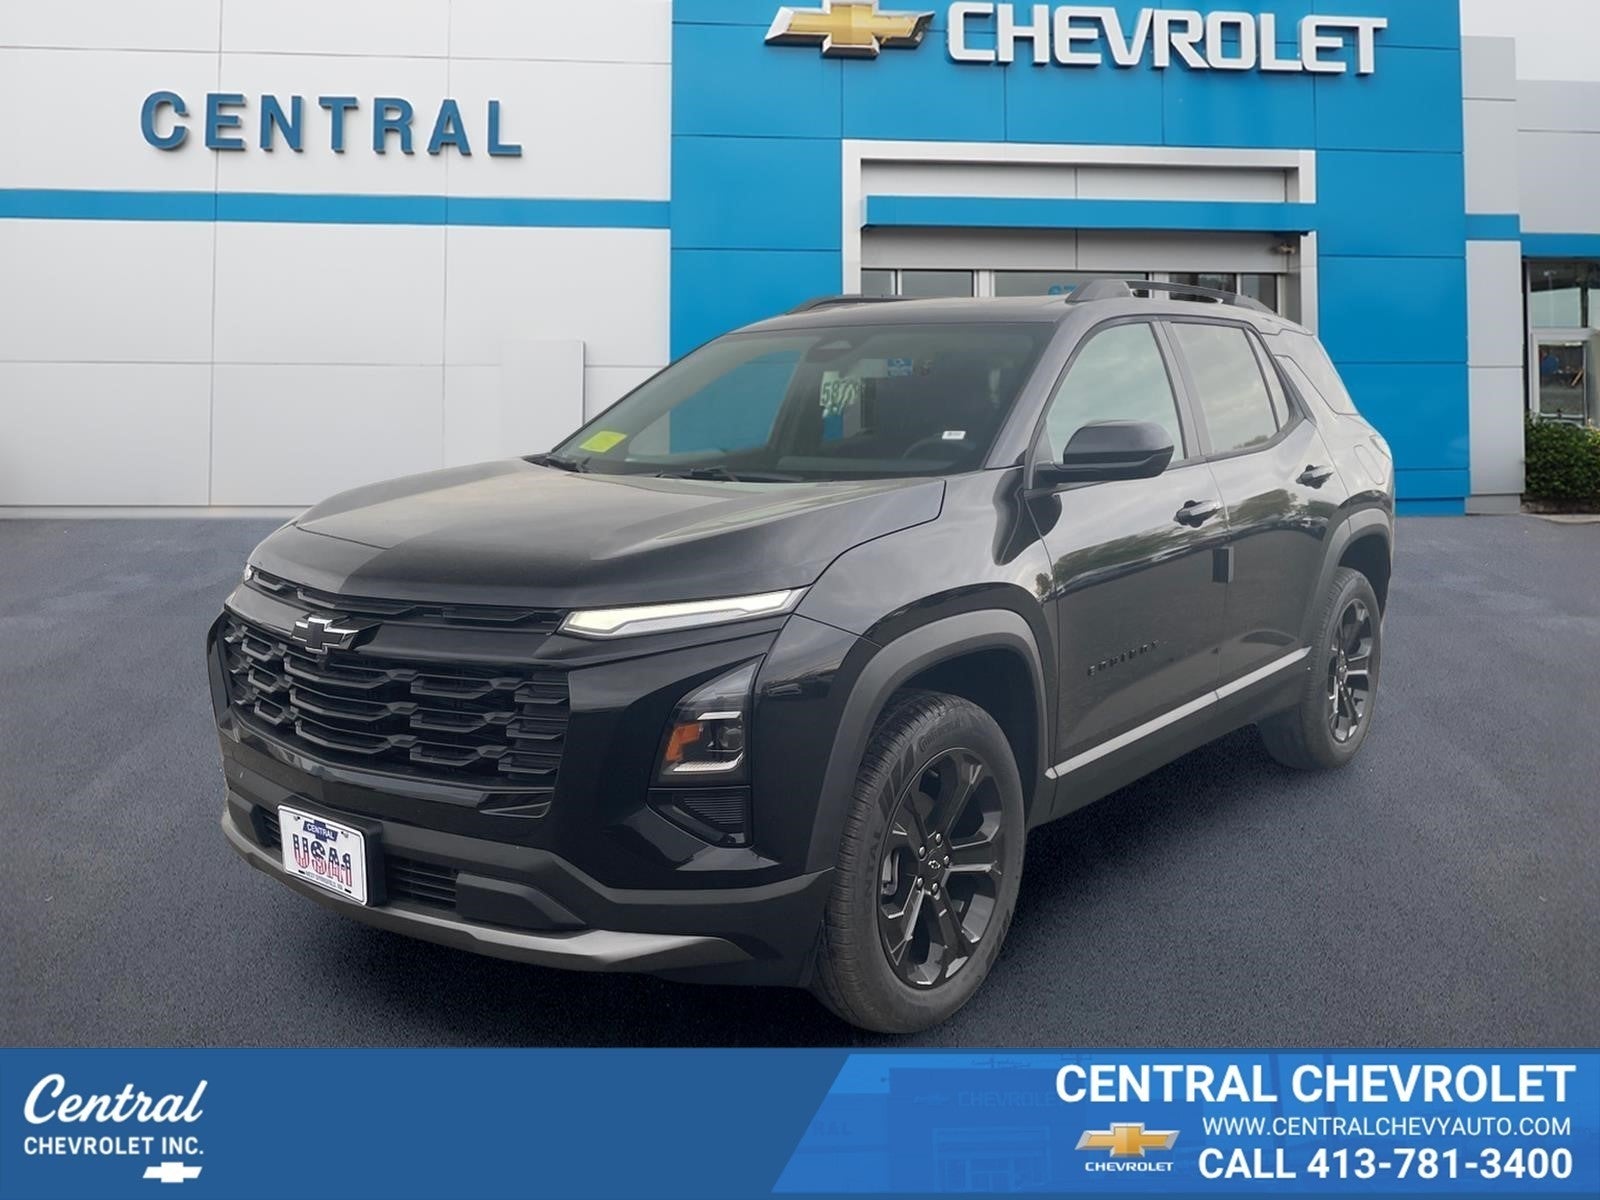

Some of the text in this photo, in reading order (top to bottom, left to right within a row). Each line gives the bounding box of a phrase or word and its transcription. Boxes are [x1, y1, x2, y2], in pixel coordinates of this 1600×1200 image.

[947, 1, 1388, 73] CHEVROLET
[140, 91, 523, 157] CENTRAL
[306, 823, 336, 841] CENTRAL
